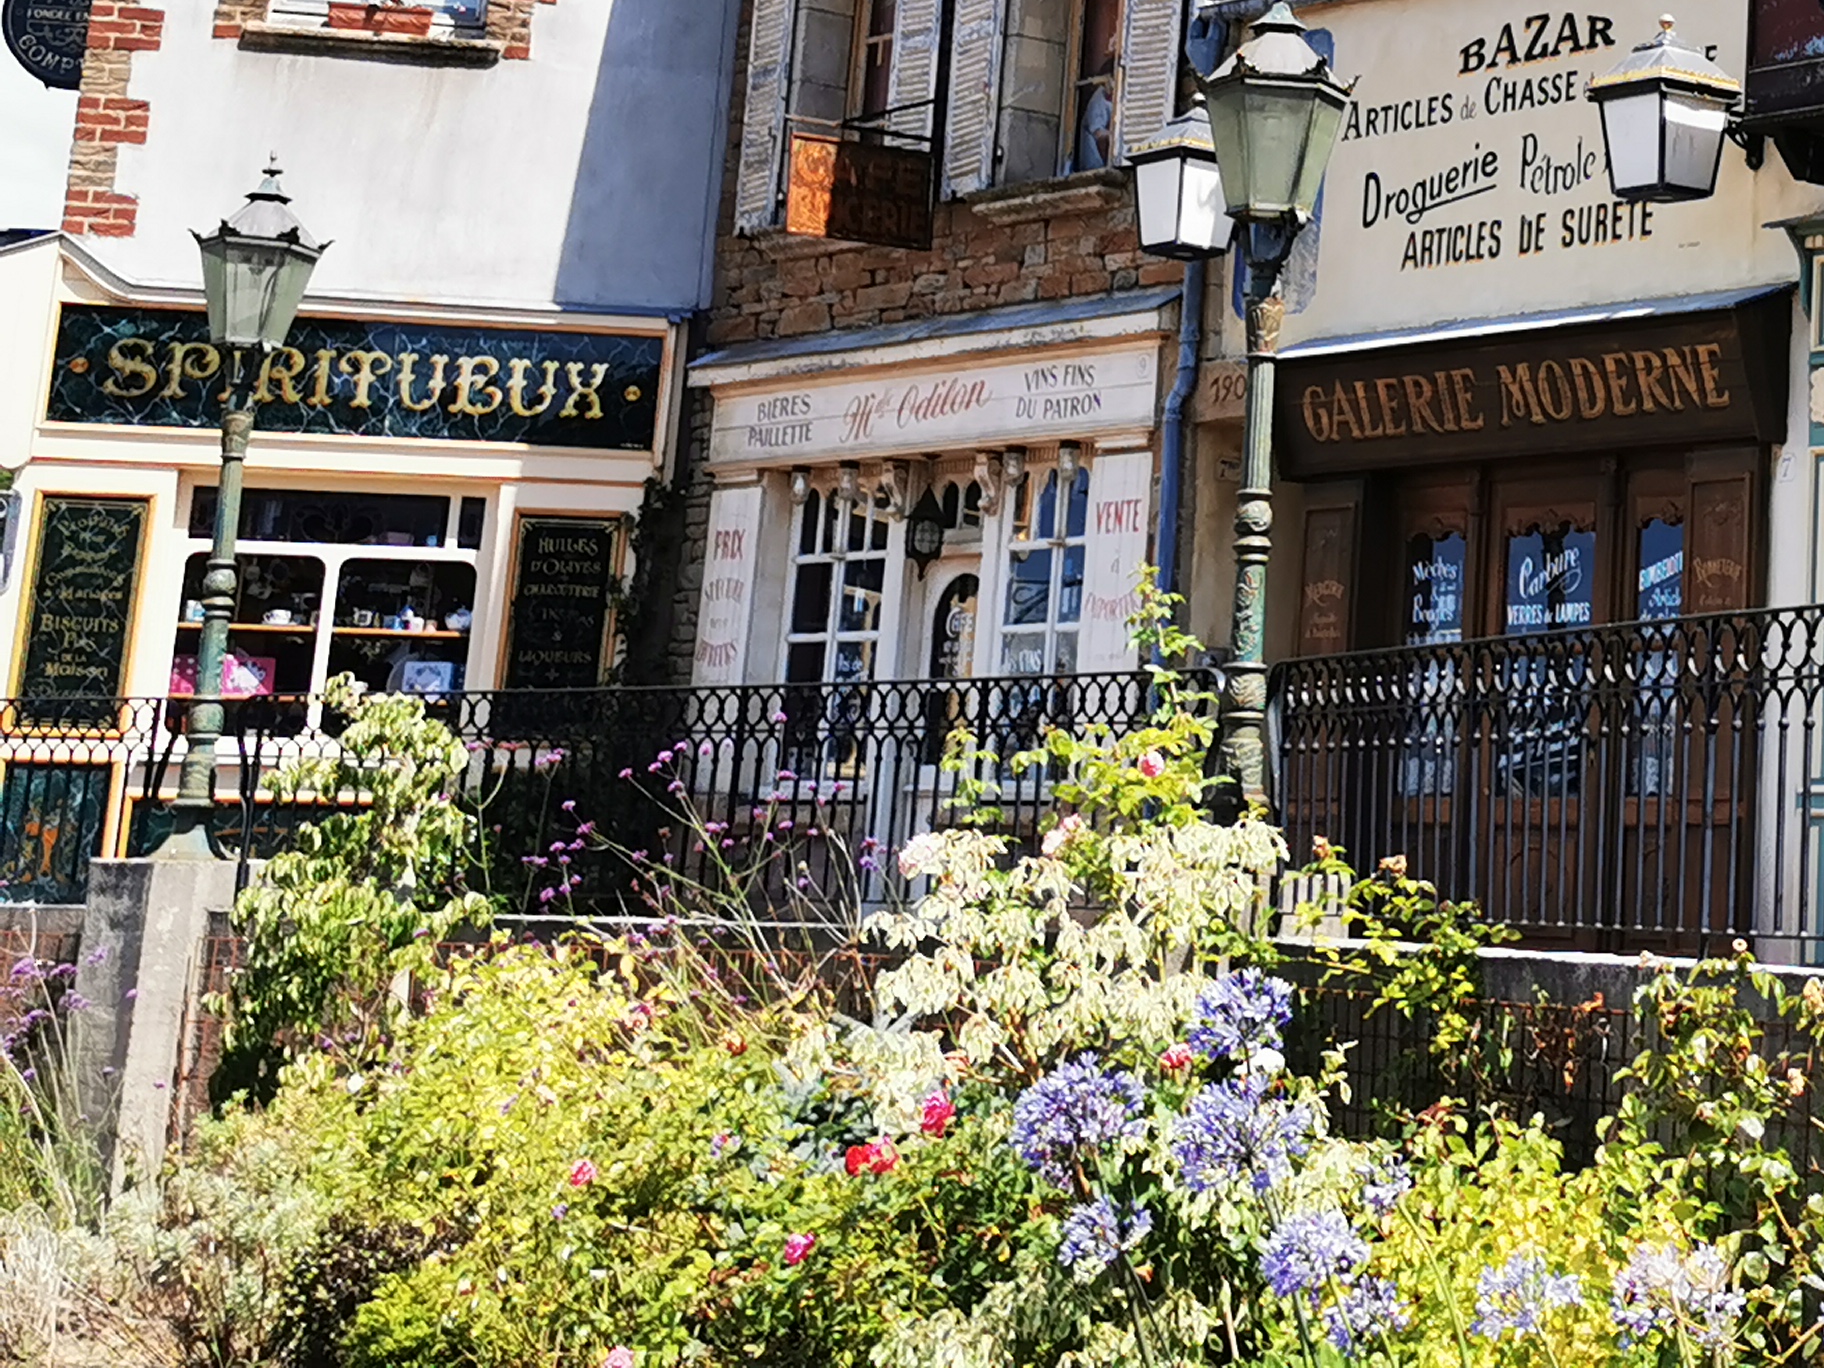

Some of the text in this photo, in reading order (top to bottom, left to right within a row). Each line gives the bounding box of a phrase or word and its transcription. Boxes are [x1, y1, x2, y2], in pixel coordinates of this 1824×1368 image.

[1458, 12, 1616, 77] BAZAR
[1341, 92, 1454, 142] ARTICLES
[1460, 94, 1478, 121] de
[1484, 70, 1579, 117] CHASSE
[1361, 142, 1499, 229] Droguerie
[1400, 200, 1654, 272] ARTICLES DE SURETE
[895, 376, 994, 430] Odilon
[1016, 392, 1102, 420] DU PATRON
[1023, 363, 1097, 393] VINS FINS
[1302, 342, 1730, 444] GALERIE MODERNE
[748, 421, 813, 448] PAILLETTE
[1096, 498, 1142, 535] VENTE
